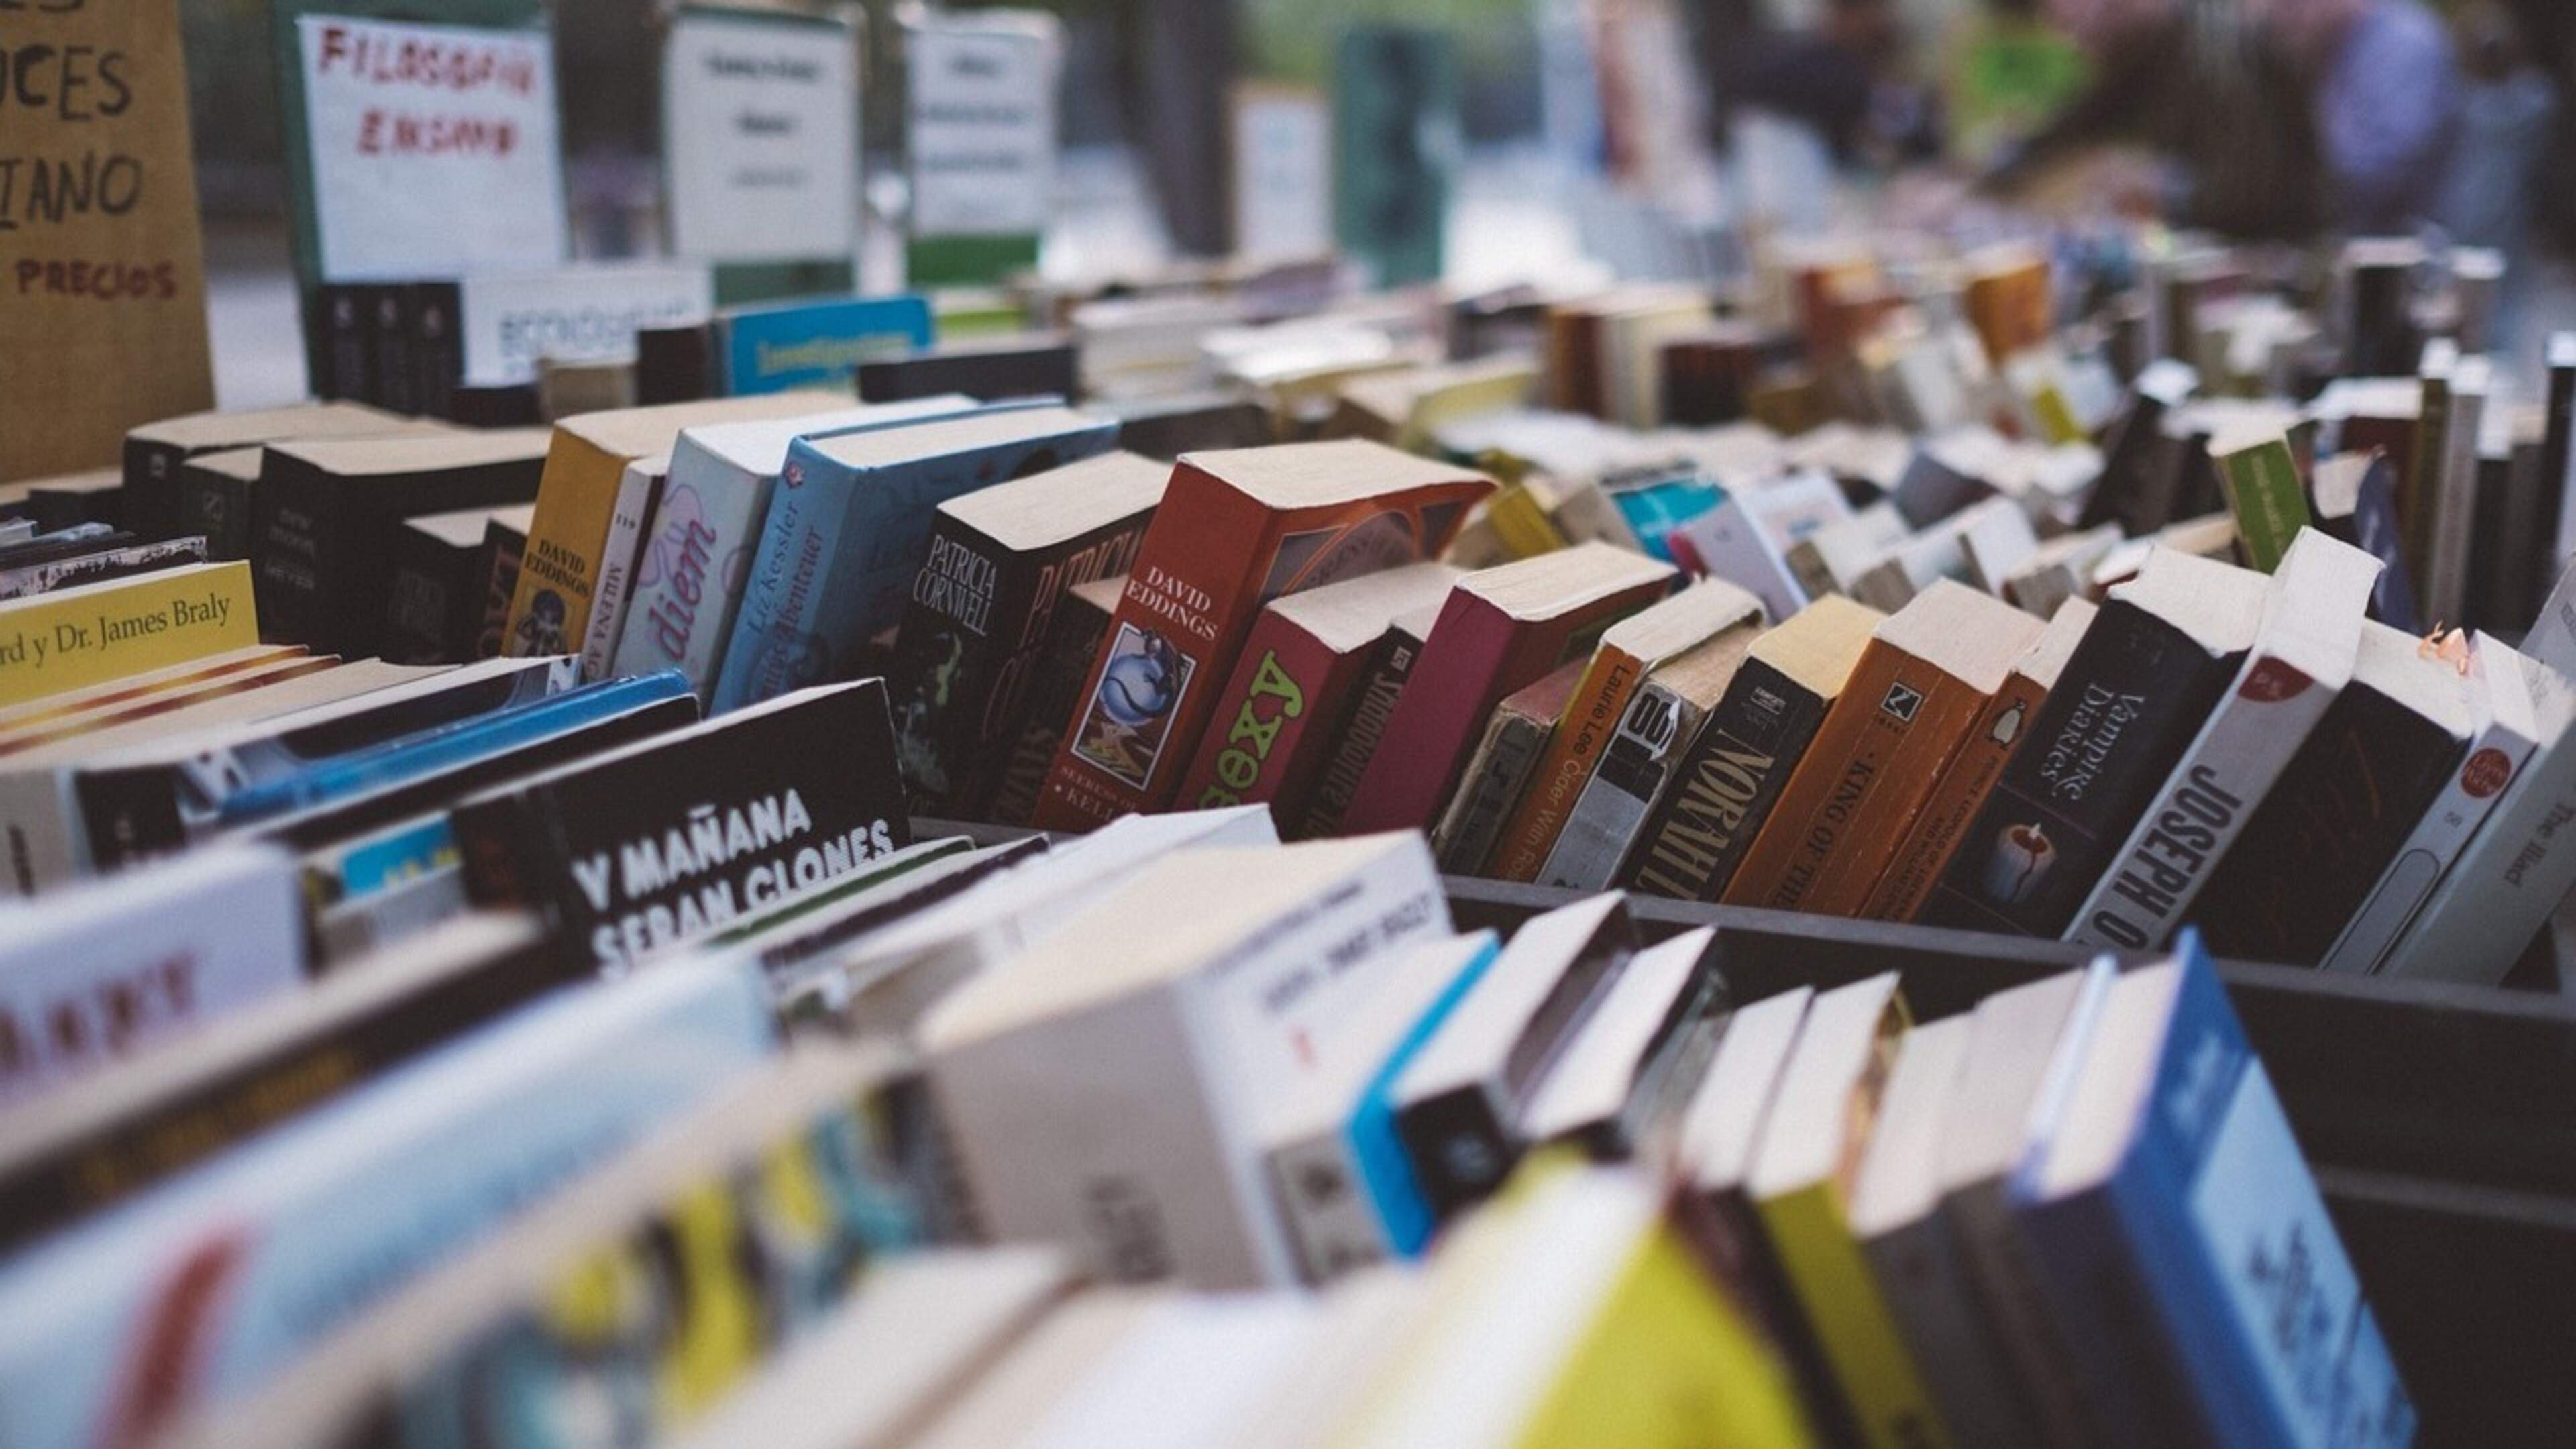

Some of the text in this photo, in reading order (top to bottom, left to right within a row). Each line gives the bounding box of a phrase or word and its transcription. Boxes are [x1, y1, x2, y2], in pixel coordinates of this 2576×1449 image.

[17, 257, 180, 301] PRECIOS
[525, 551, 590, 598] EDDINGS
[539, 539, 586, 573] DAVID
[759, 500, 800, 593] Kessler
[926, 534, 998, 600] PATRICIA
[645, 519, 718, 663] diem
[913, 567, 991, 637] CORNWELL
[1126, 579, 1218, 641] EDDINGS
[1147, 566, 1211, 612] DAVID
[33, 637, 48, 669] y
[56, 623, 93, 654] Dr.
[98, 610, 168, 651] James
[172, 592, 231, 627] Braly
[1592, 664, 1630, 720] Laurie
[1573, 721, 1604, 756] Lee
[2040, 682, 2106, 782] Diaries
[2052, 692, 2145, 801] Vampire
[1546, 758, 1582, 806] Cider
[1652, 729, 1775, 884] NORAH
[1825, 760, 1874, 824] KING
[571, 788, 812, 912] Y MAÑANA
[746, 818, 895, 910] CLONES
[1807, 826, 1835, 861] OF
[2112, 765, 2243, 919] JOSEPH
[2503, 840, 2547, 889] Iliad
